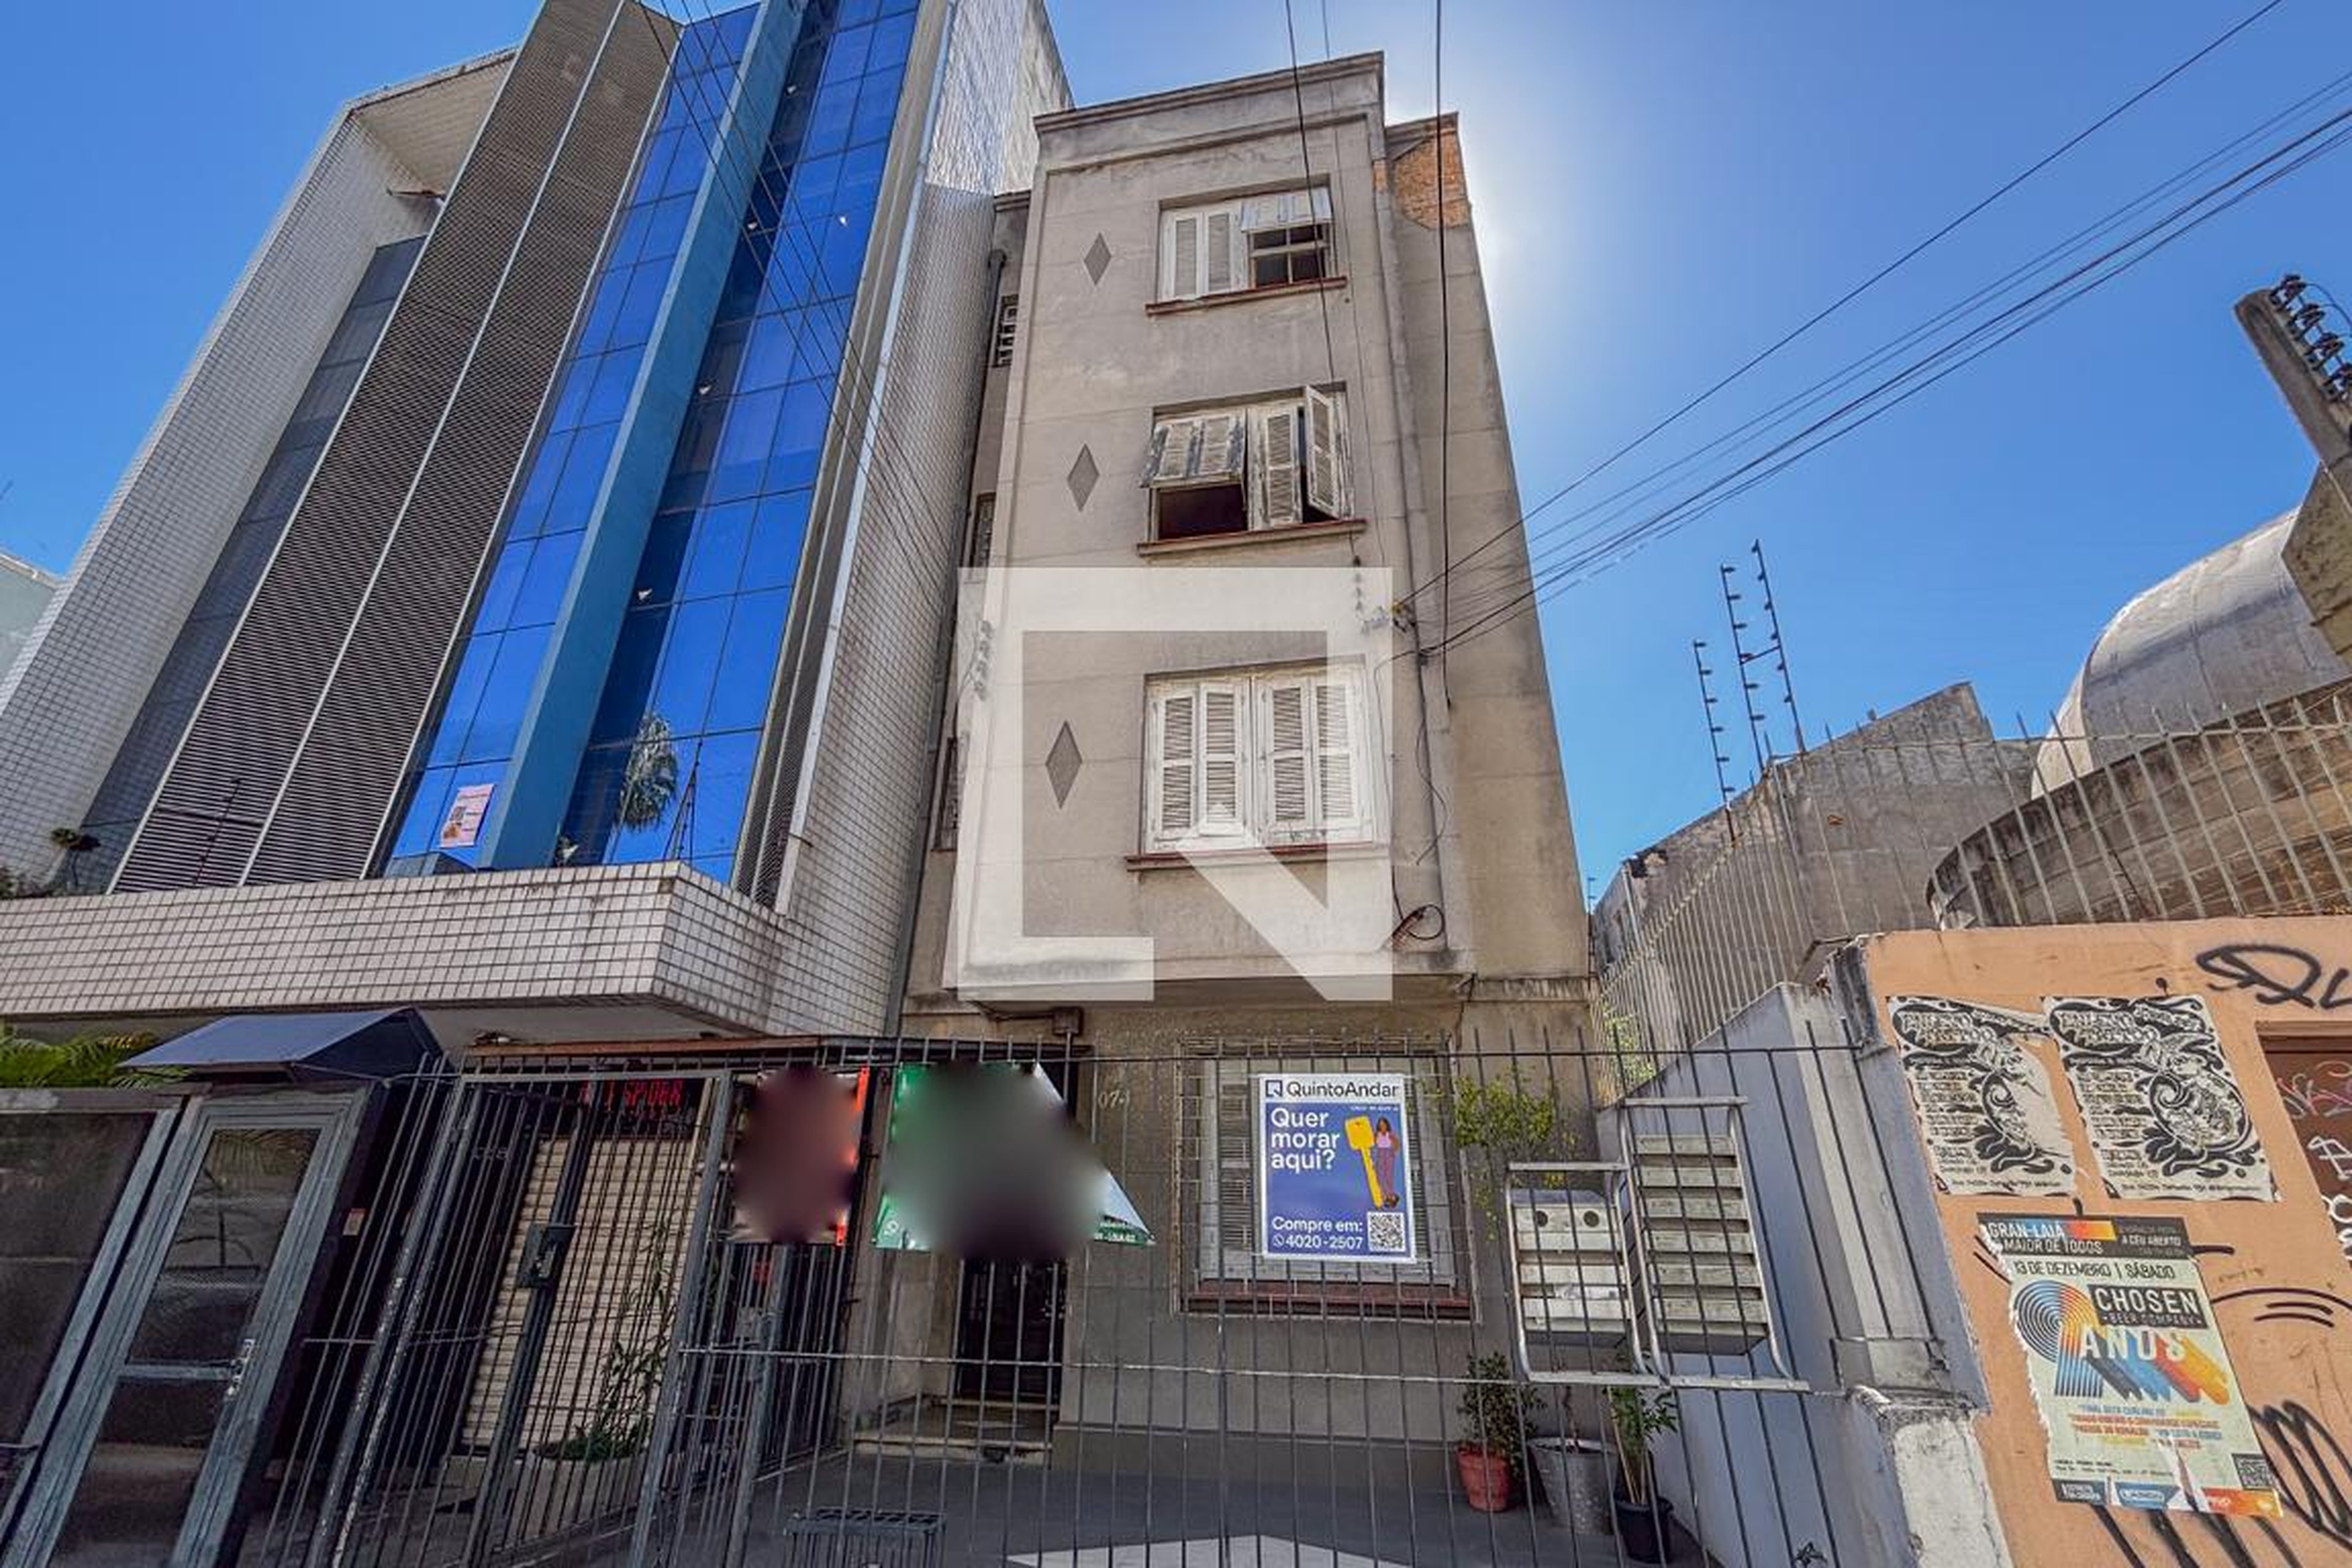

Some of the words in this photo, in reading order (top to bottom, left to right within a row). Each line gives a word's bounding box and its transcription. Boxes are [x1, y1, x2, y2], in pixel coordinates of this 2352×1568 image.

[1286, 1081, 1399, 1097] QuintoAndar
[1270, 1107, 1329, 1128] Quer
[1270, 1133, 1340, 1148] morar
[1270, 1149, 1335, 1174] aqui?
[1272, 1216, 1332, 1233] Compre
[1335, 1221, 1363, 1232] em:
[1286, 1235, 1363, 1250] 4020-2507
[2004, 1238, 2044, 1253] MAIOR
[2045, 1239, 2061, 1253] DE
[2028, 1261, 2045, 1275] DE
[2046, 1261, 2112, 1277] DEZEMBRO
[2094, 1287, 2199, 1314] CHOSEN
